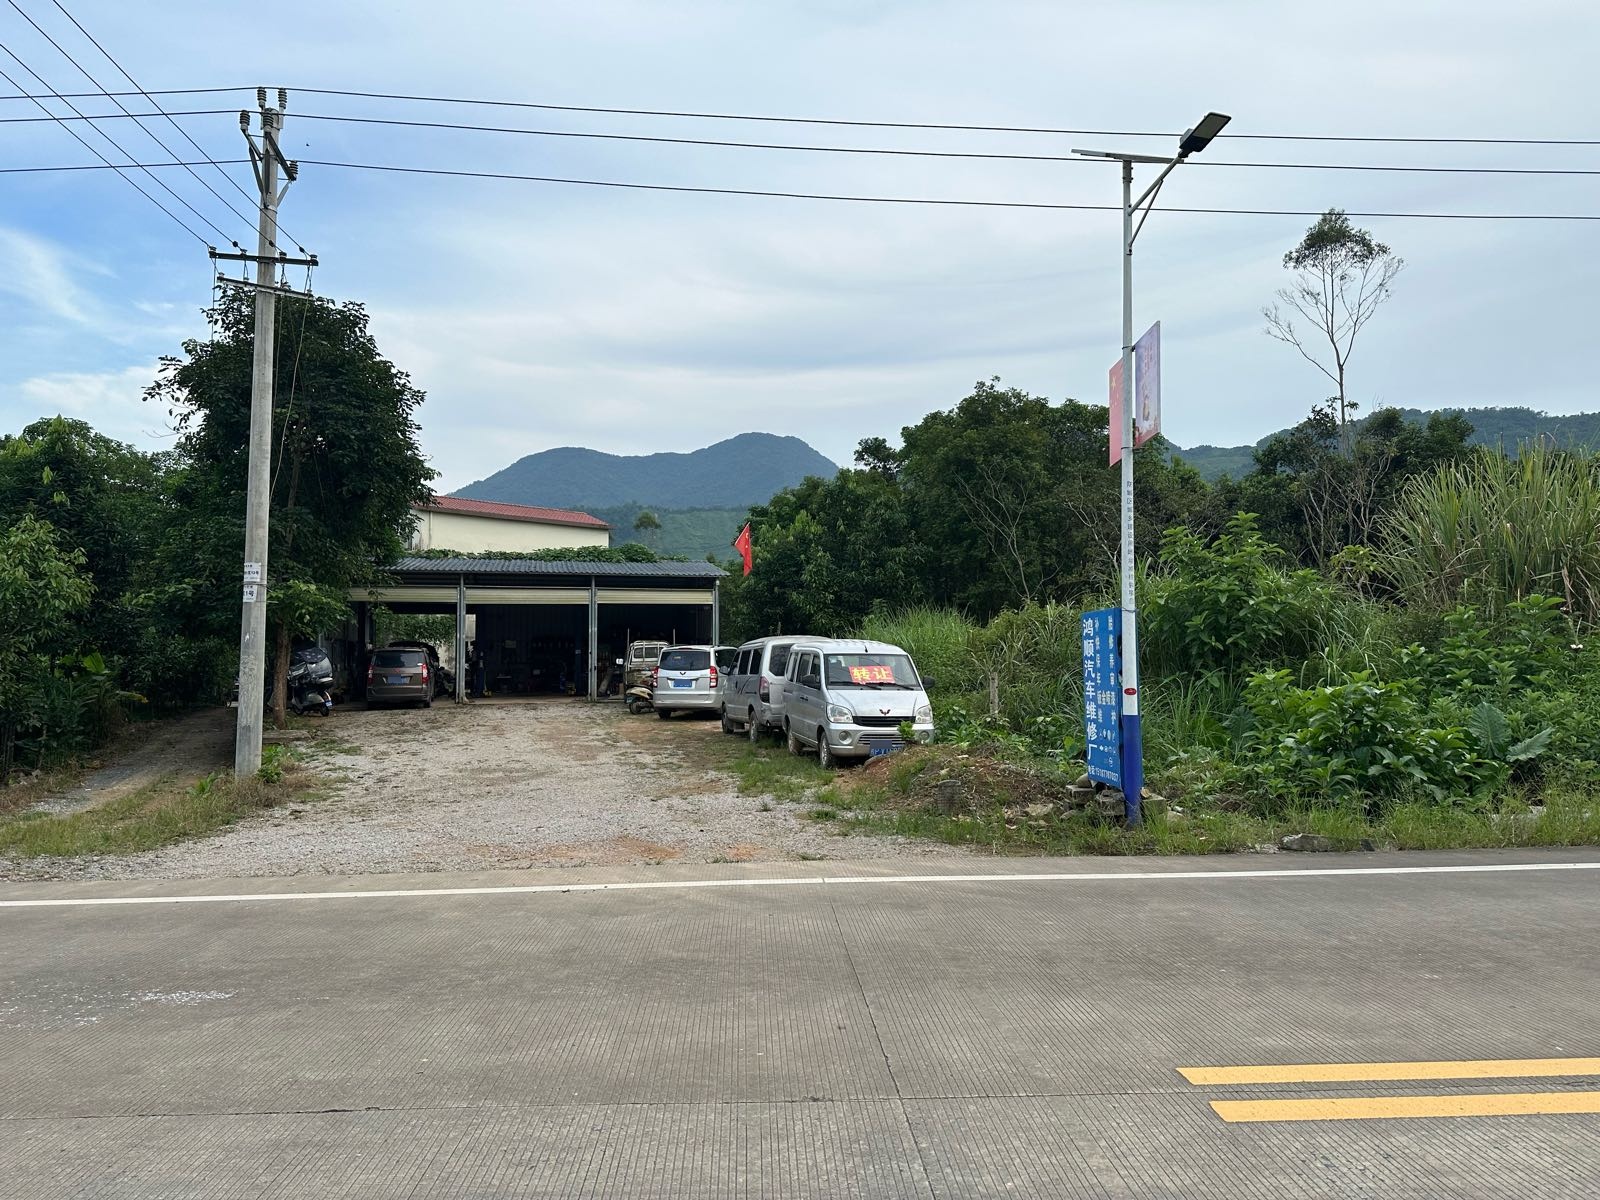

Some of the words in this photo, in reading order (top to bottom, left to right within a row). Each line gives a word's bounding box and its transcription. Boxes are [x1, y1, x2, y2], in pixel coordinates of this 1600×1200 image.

[852, 666, 889, 680] 转让
[1083, 617, 1098, 760] 鸿顺汽车维修厂
